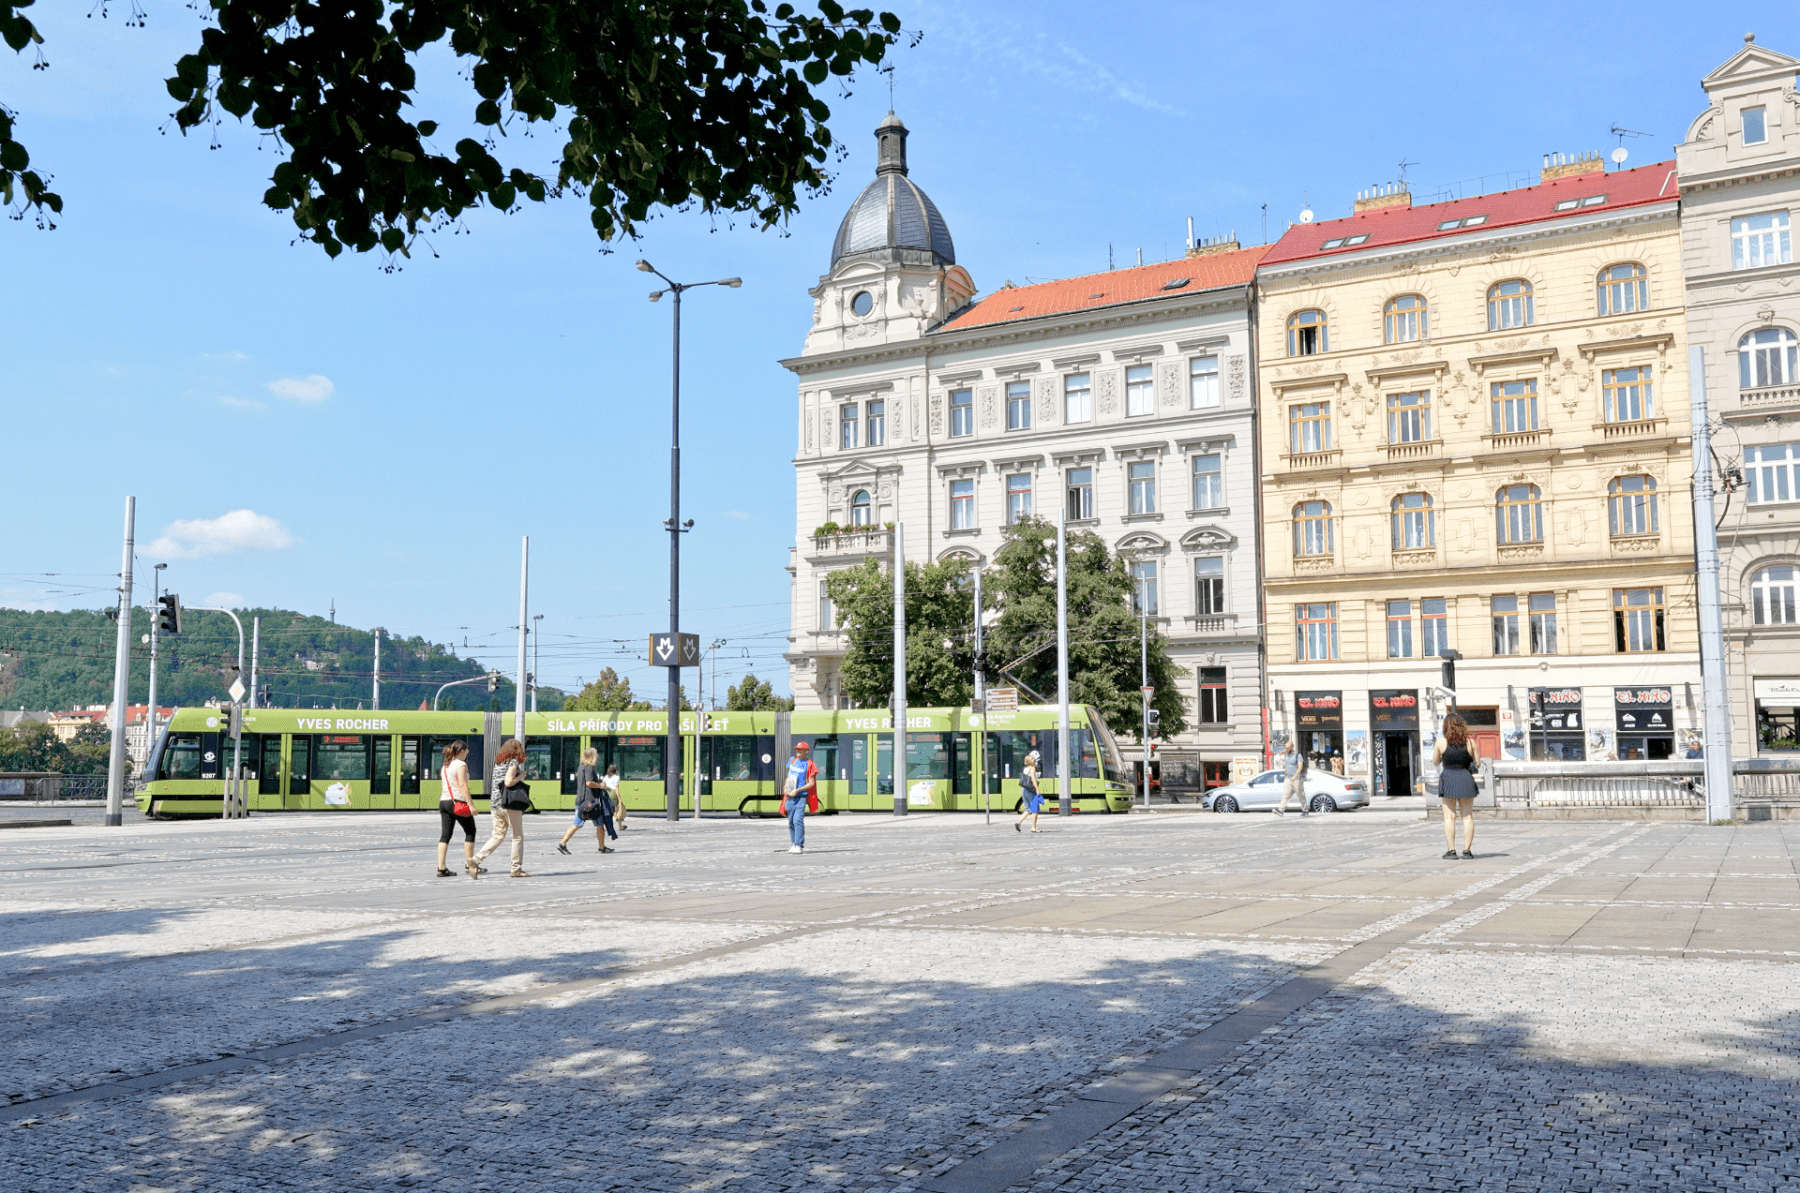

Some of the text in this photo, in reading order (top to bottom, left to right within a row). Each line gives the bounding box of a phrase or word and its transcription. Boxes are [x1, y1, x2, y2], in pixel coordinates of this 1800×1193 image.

[297, 718, 389, 730] YVES ROCHER
[547, 718, 575, 731] SÍLA
[579, 718, 633, 731] PŘÍRODY
[637, 720, 662, 731] PRO
[666, 718, 694, 731] ŠI
[846, 717, 931, 729] YVES RHER
[323, 735, 330, 743] 3
